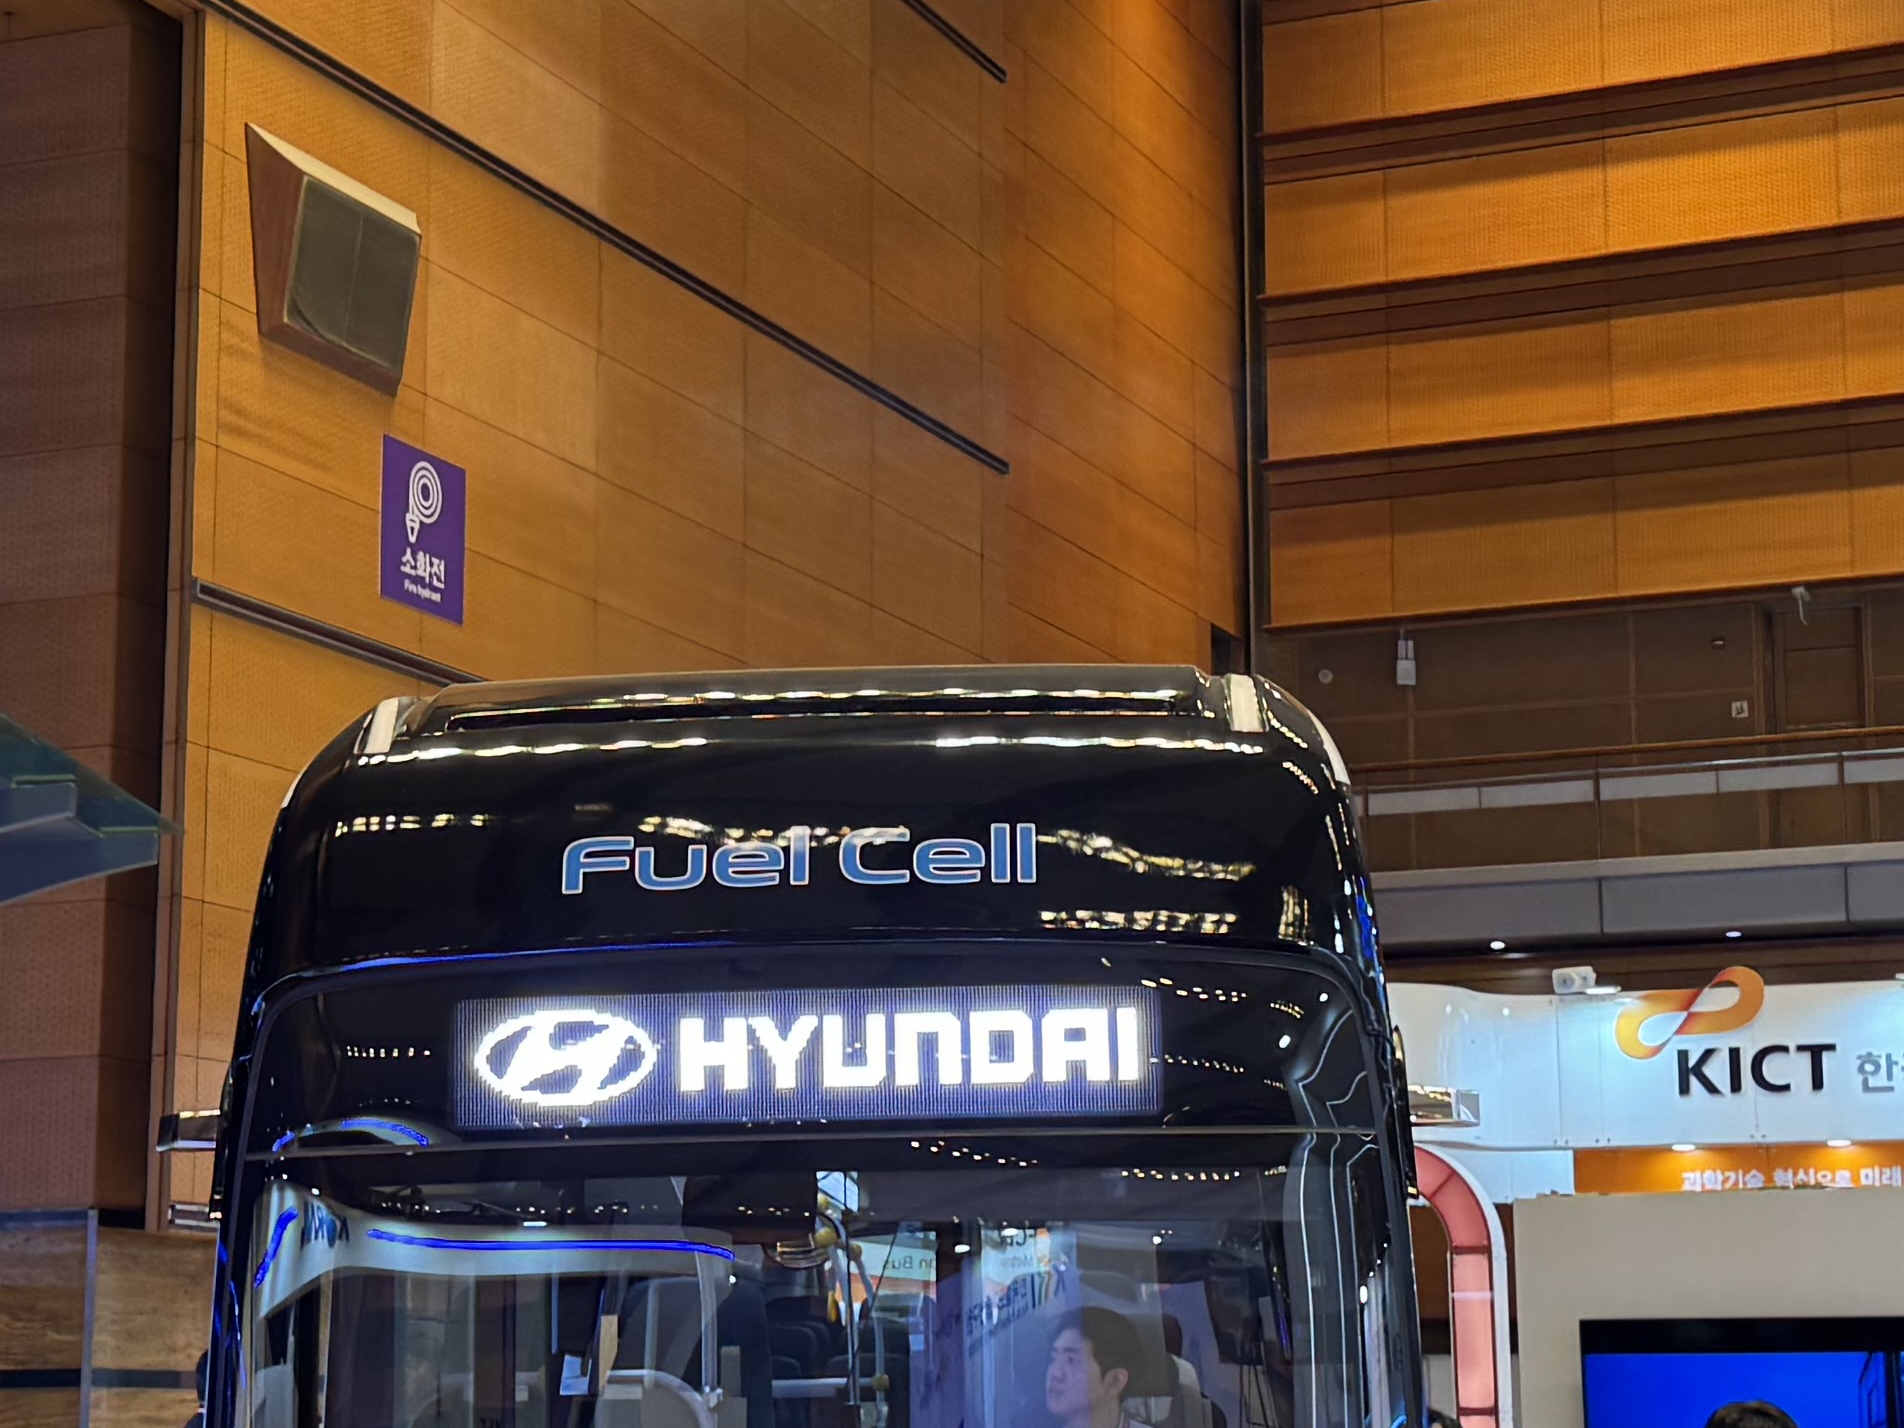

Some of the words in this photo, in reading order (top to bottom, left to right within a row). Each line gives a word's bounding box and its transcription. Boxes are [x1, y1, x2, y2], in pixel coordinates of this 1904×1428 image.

[400, 547, 445, 589] 소화전
[404, 579, 417, 595] Fire
[560, 826, 812, 896] Fuel
[839, 822, 1039, 887] Cell
[677, 1008, 1140, 1093] HYUNDAI
[1677, 1042, 1836, 1097] KICT
